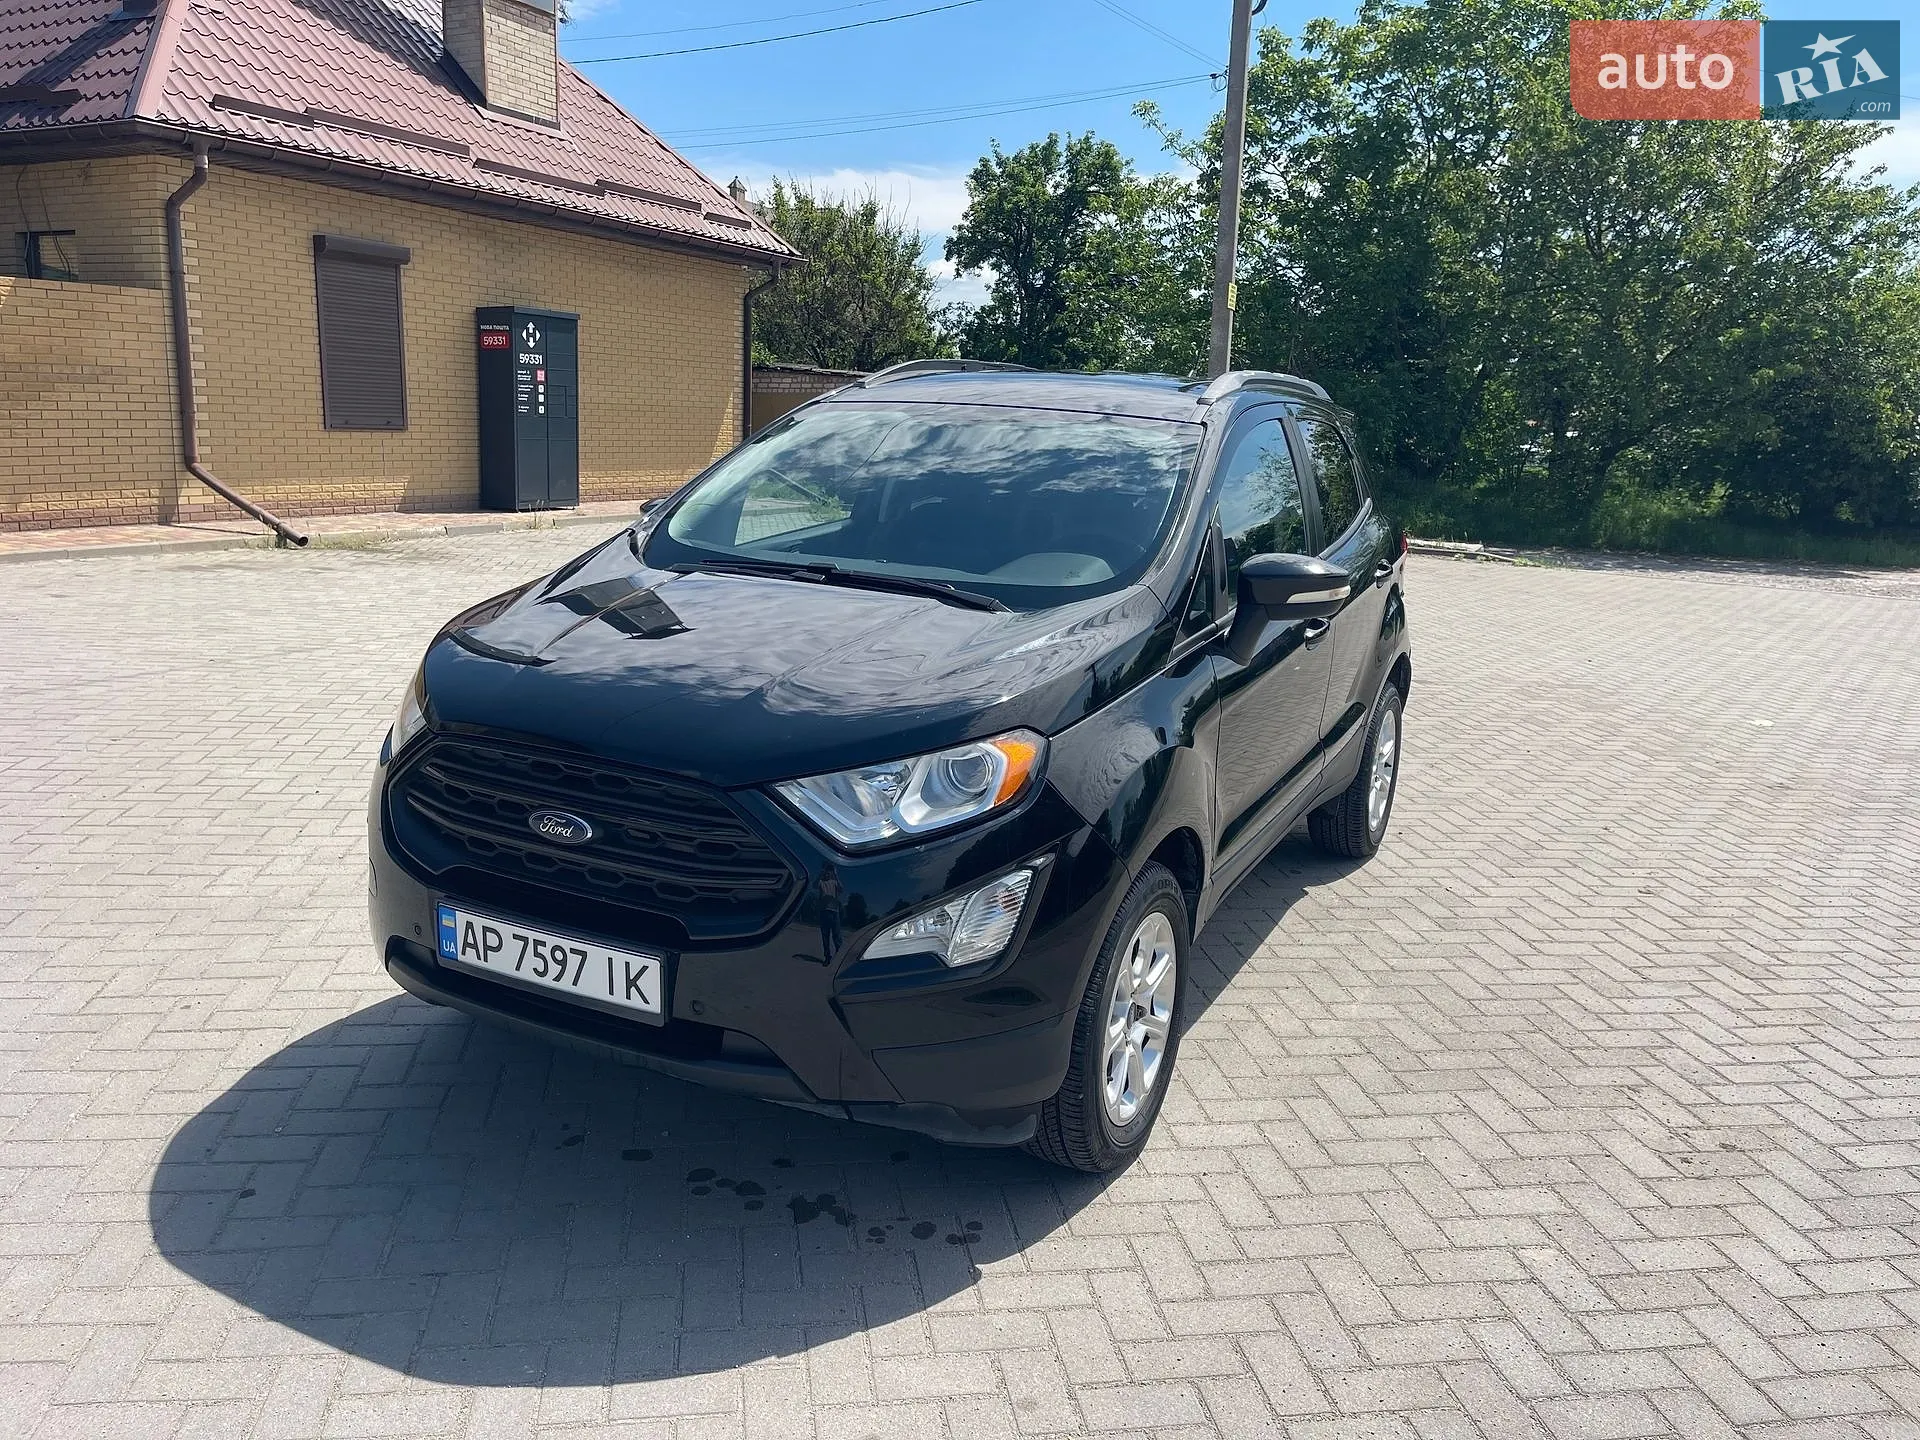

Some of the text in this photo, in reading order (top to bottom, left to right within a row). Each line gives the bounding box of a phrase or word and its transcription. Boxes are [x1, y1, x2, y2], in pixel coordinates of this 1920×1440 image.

[483, 336, 506, 346] 59331
[519, 353, 543, 365] 59331
[540, 816, 574, 837] Ford
[443, 940, 456, 953] UA
[461, 920, 650, 1005] AP 7597 IK
